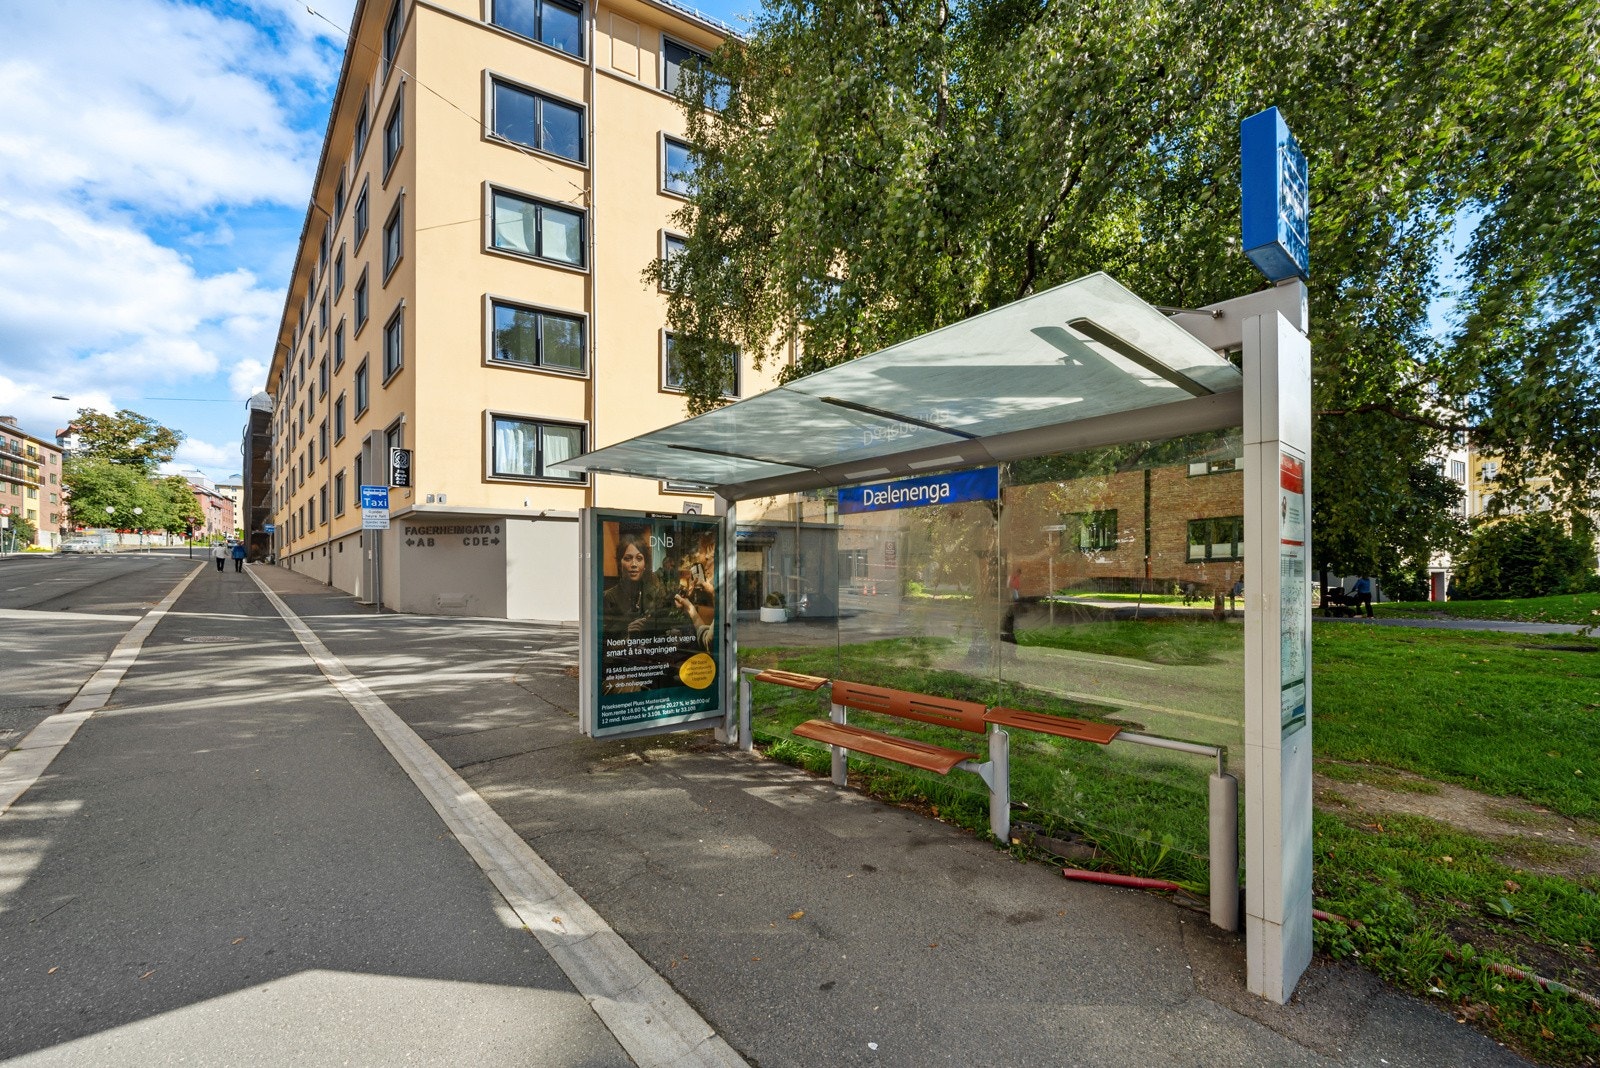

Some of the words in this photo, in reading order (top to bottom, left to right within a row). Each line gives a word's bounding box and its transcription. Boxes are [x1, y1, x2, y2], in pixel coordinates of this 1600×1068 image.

[864, 483, 950, 506] Dælenenga
[364, 498, 387, 506] Taxi
[405, 525, 491, 535] FAGERHEIMGATA
[494, 525, 500, 534] 9
[650, 532, 674, 550] DNB
[627, 637, 652, 646] ganger
[606, 649, 626, 657] smart
[628, 647, 633, 655] å
[643, 646, 677, 655] regningen
